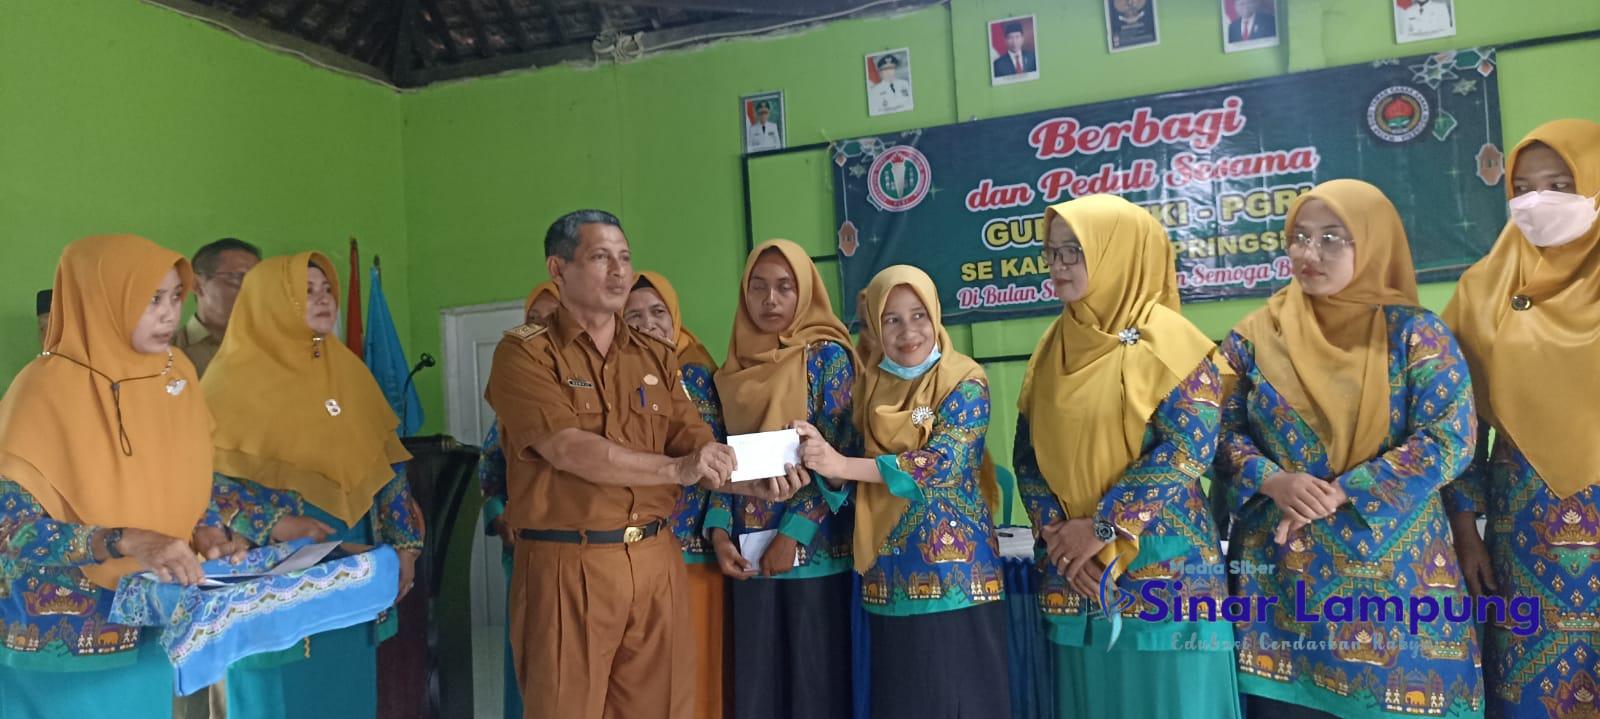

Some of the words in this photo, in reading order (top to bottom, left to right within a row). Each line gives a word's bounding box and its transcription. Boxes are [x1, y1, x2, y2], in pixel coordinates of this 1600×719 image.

[1030, 96, 1245, 158] Berbagi
[966, 178, 1034, 212] dan
[1040, 159, 1157, 201] Peduli
[1166, 146, 1319, 188] Sesama
[957, 286, 981, 309] Di
[981, 283, 1038, 306] Bulan
[1191, 262, 1273, 289] Semoga
[961, 260, 993, 282] SE
